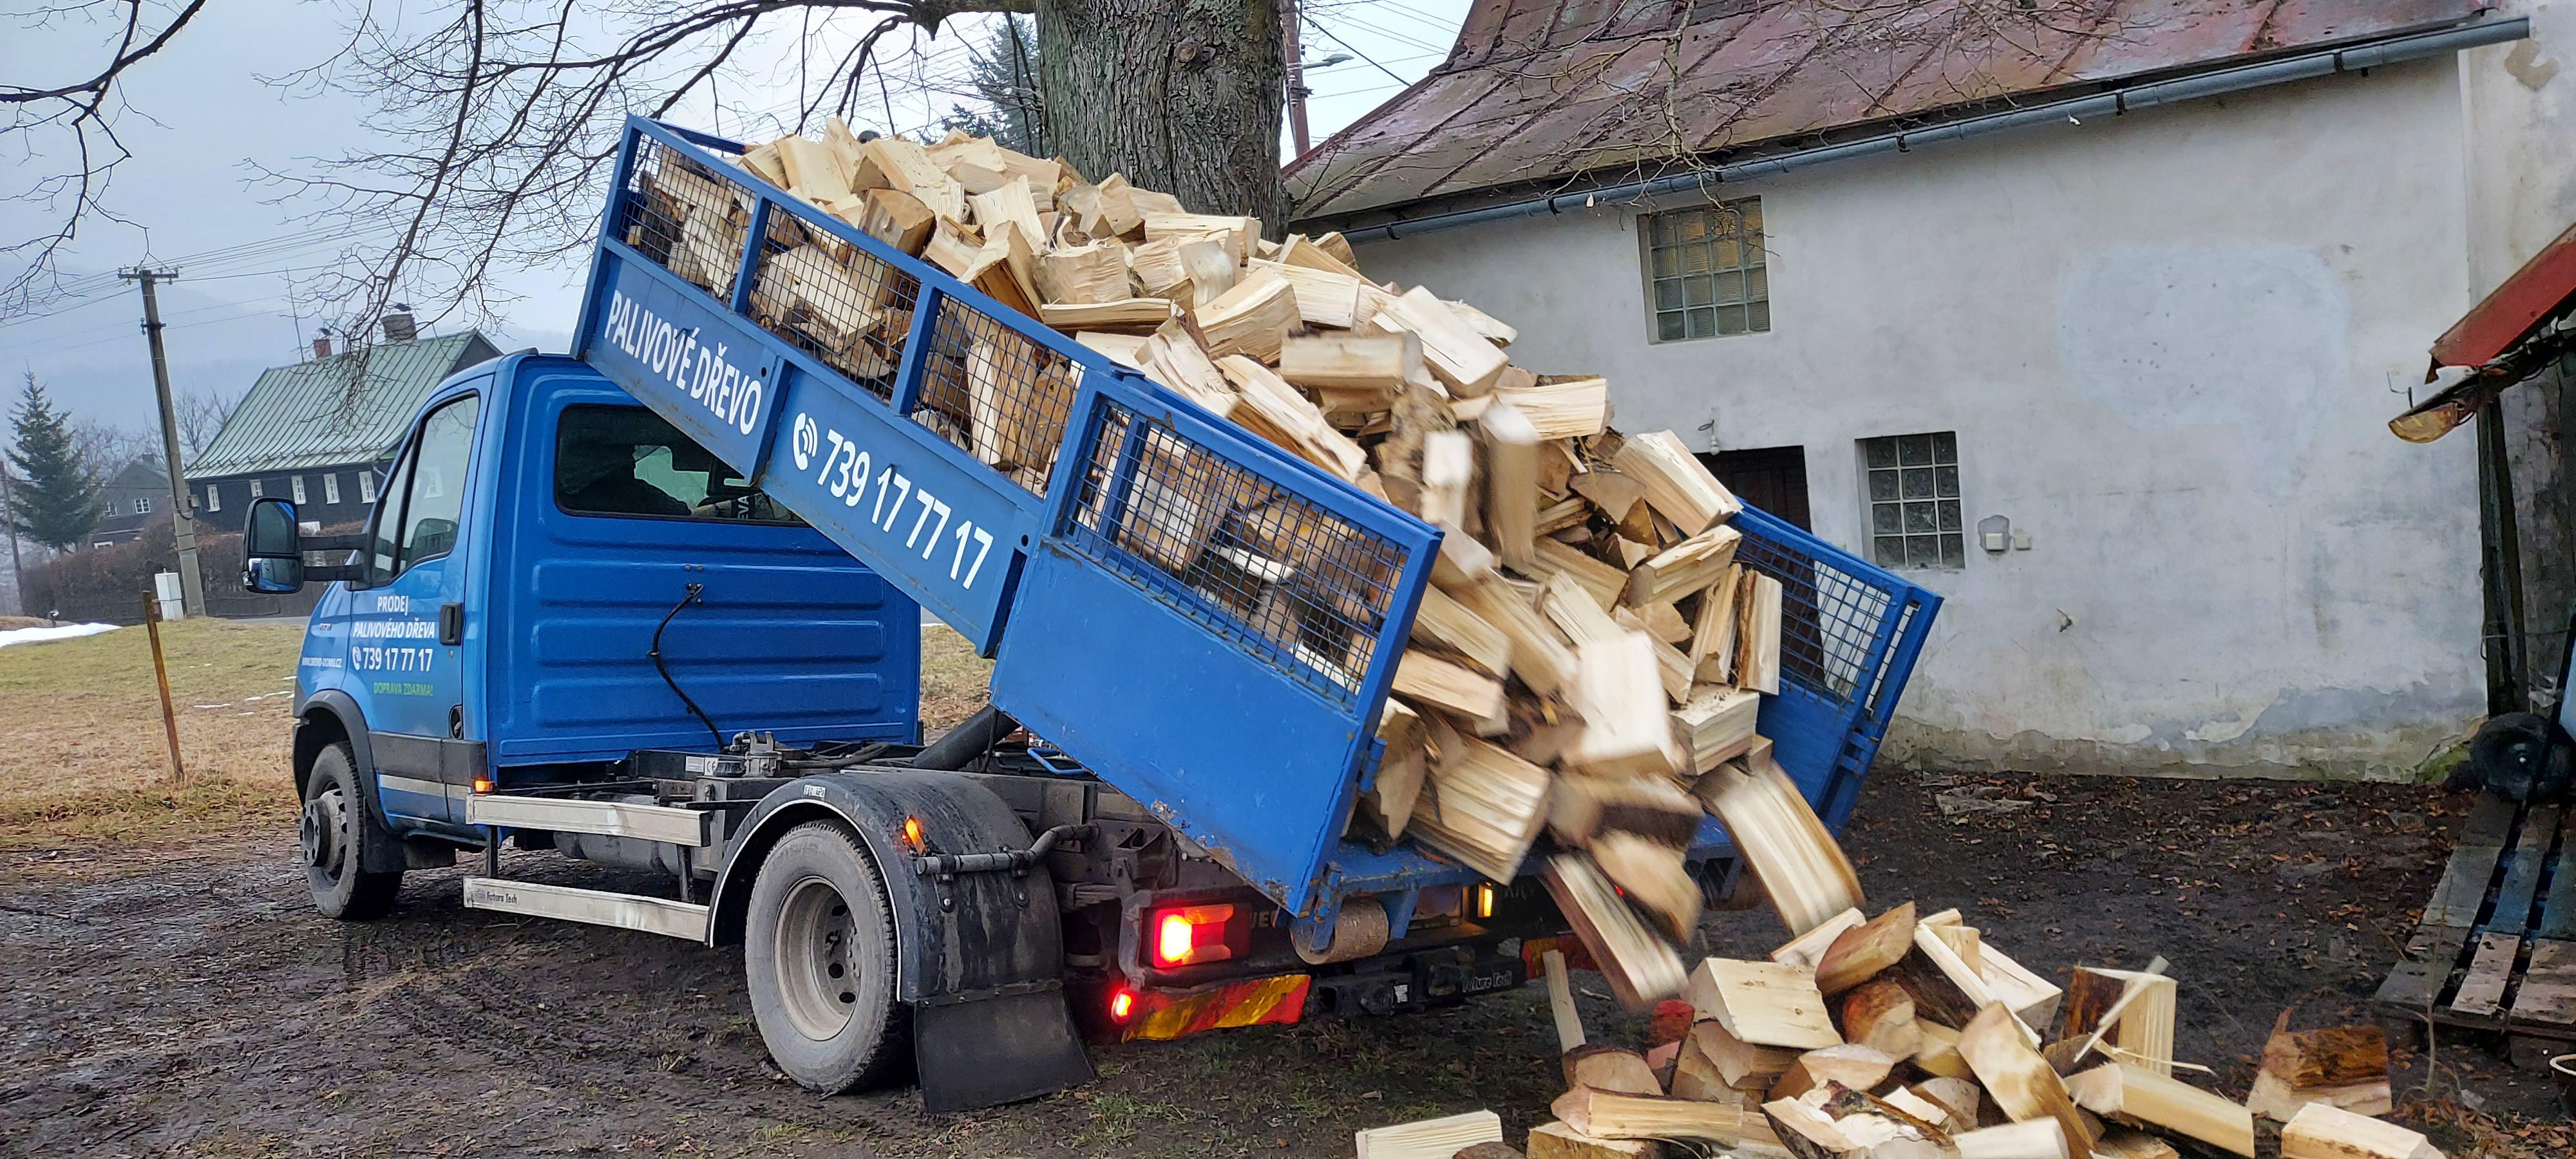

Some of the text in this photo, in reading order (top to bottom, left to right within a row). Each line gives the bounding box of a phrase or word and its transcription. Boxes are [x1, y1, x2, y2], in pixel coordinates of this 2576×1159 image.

[605, 290, 762, 435] PALIVOVÉ DŘEVO
[817, 429, 994, 590] 739 17 77 17
[377, 596, 408, 616] PRODEJ
[353, 617, 435, 638] PALIVOVÉHO DŘEVA
[363, 647, 433, 672] 739 17 77 17
[374, 683, 433, 696] DOPRAVA ZDARMA!
